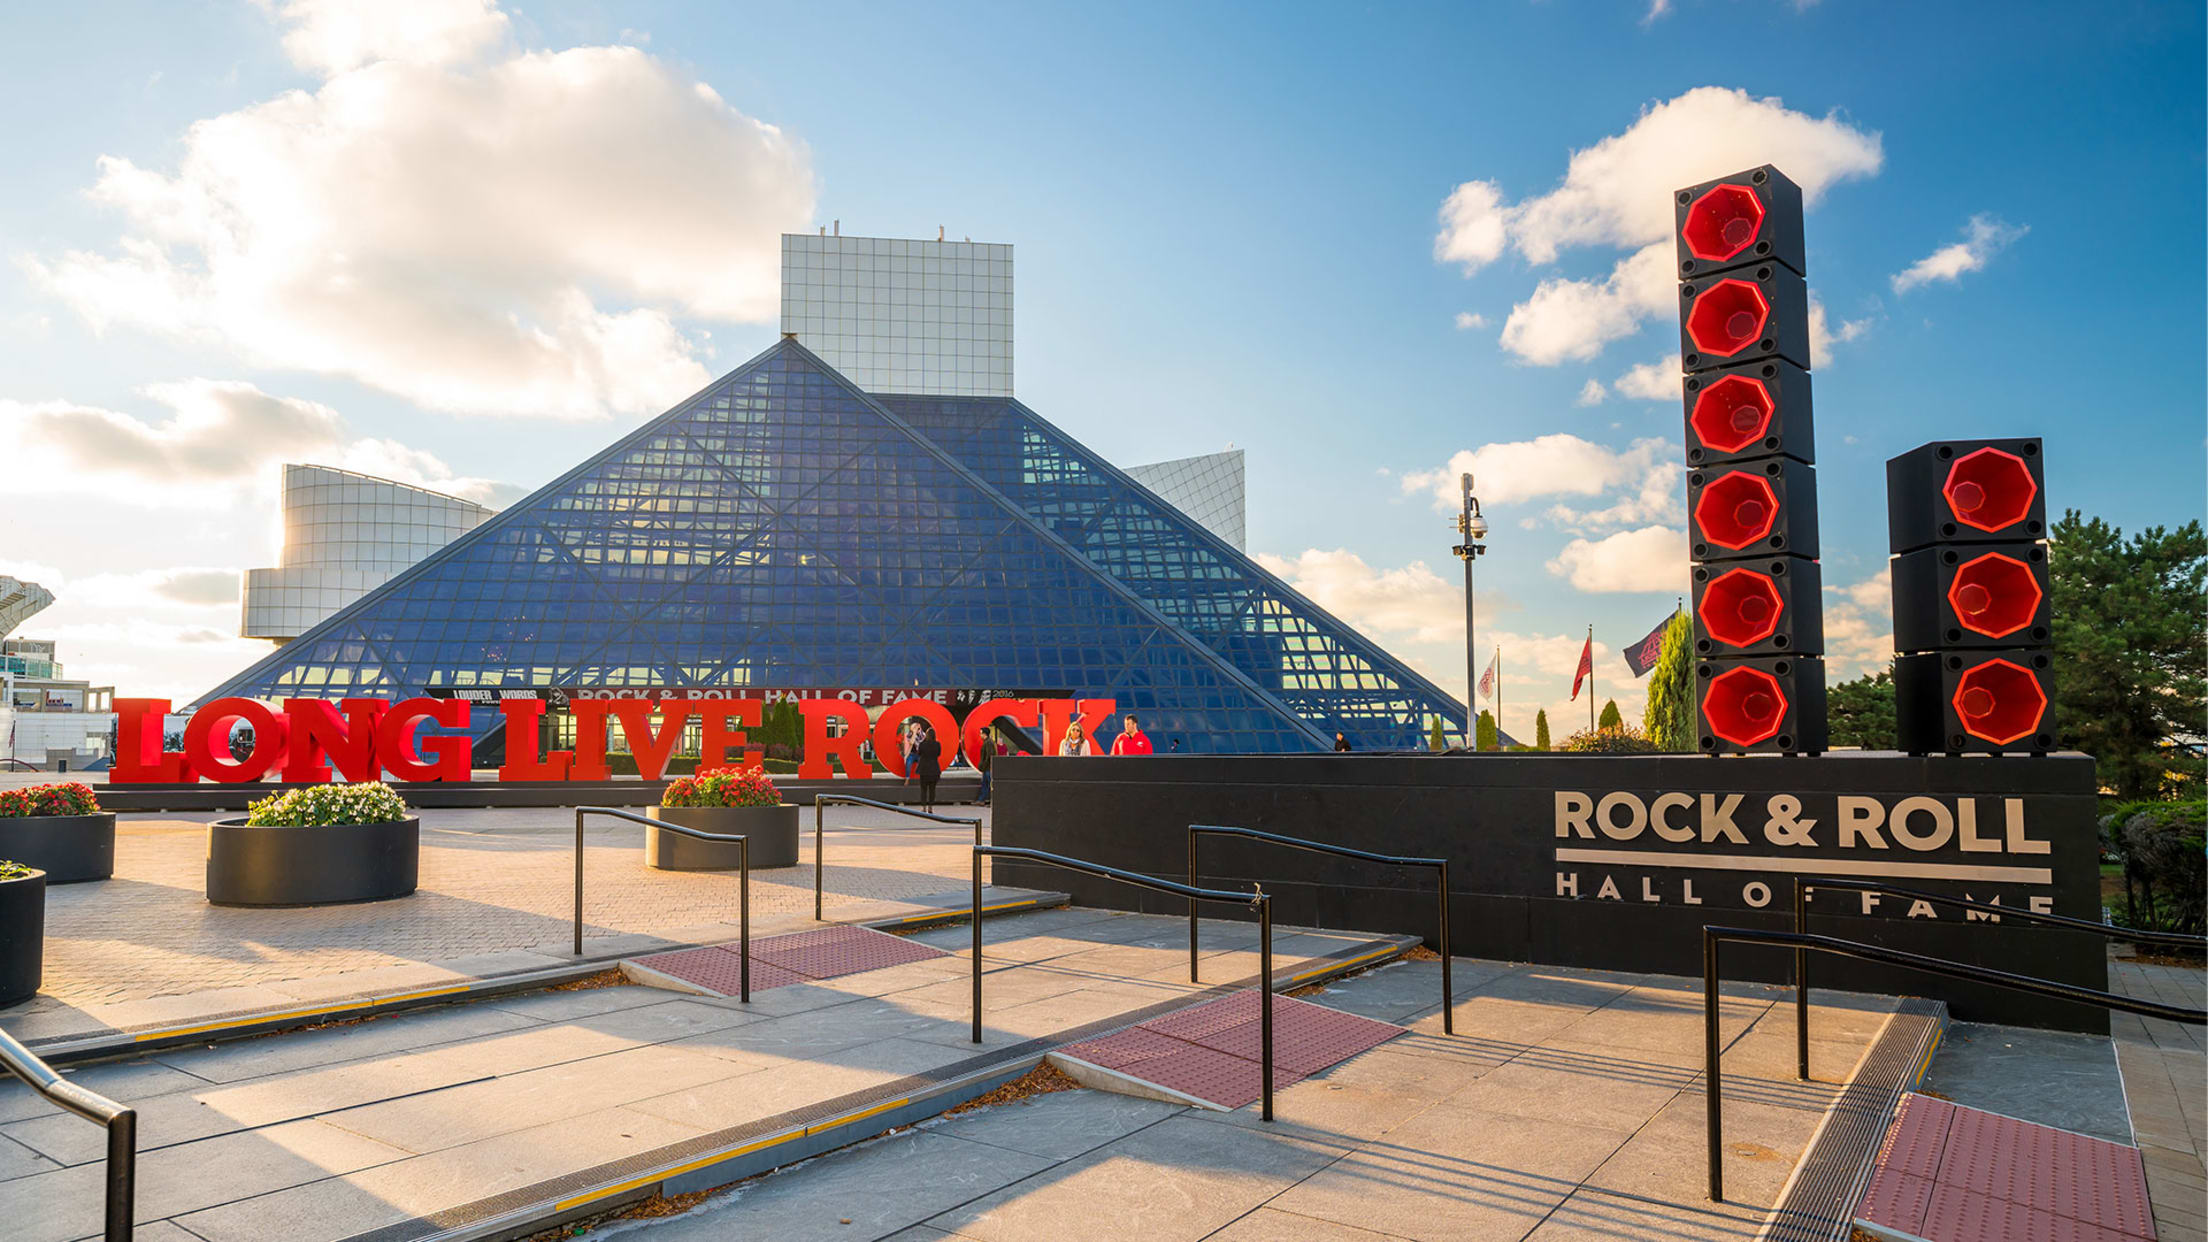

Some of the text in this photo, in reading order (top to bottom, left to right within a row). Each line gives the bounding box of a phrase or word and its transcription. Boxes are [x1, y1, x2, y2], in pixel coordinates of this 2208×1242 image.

[577, 689, 650, 701] ROCK
[659, 689, 679, 700] &
[837, 689, 873, 704] OF
[882, 689, 948, 704] FAME
[992, 689, 1015, 698] 2016
[109, 697, 1117, 784] LONG LIVE ROCK
[1555, 791, 2051, 855] ROCK & ROLL
[1556, 872, 1702, 905] HALL
[1861, 890, 2053, 925] FAME
